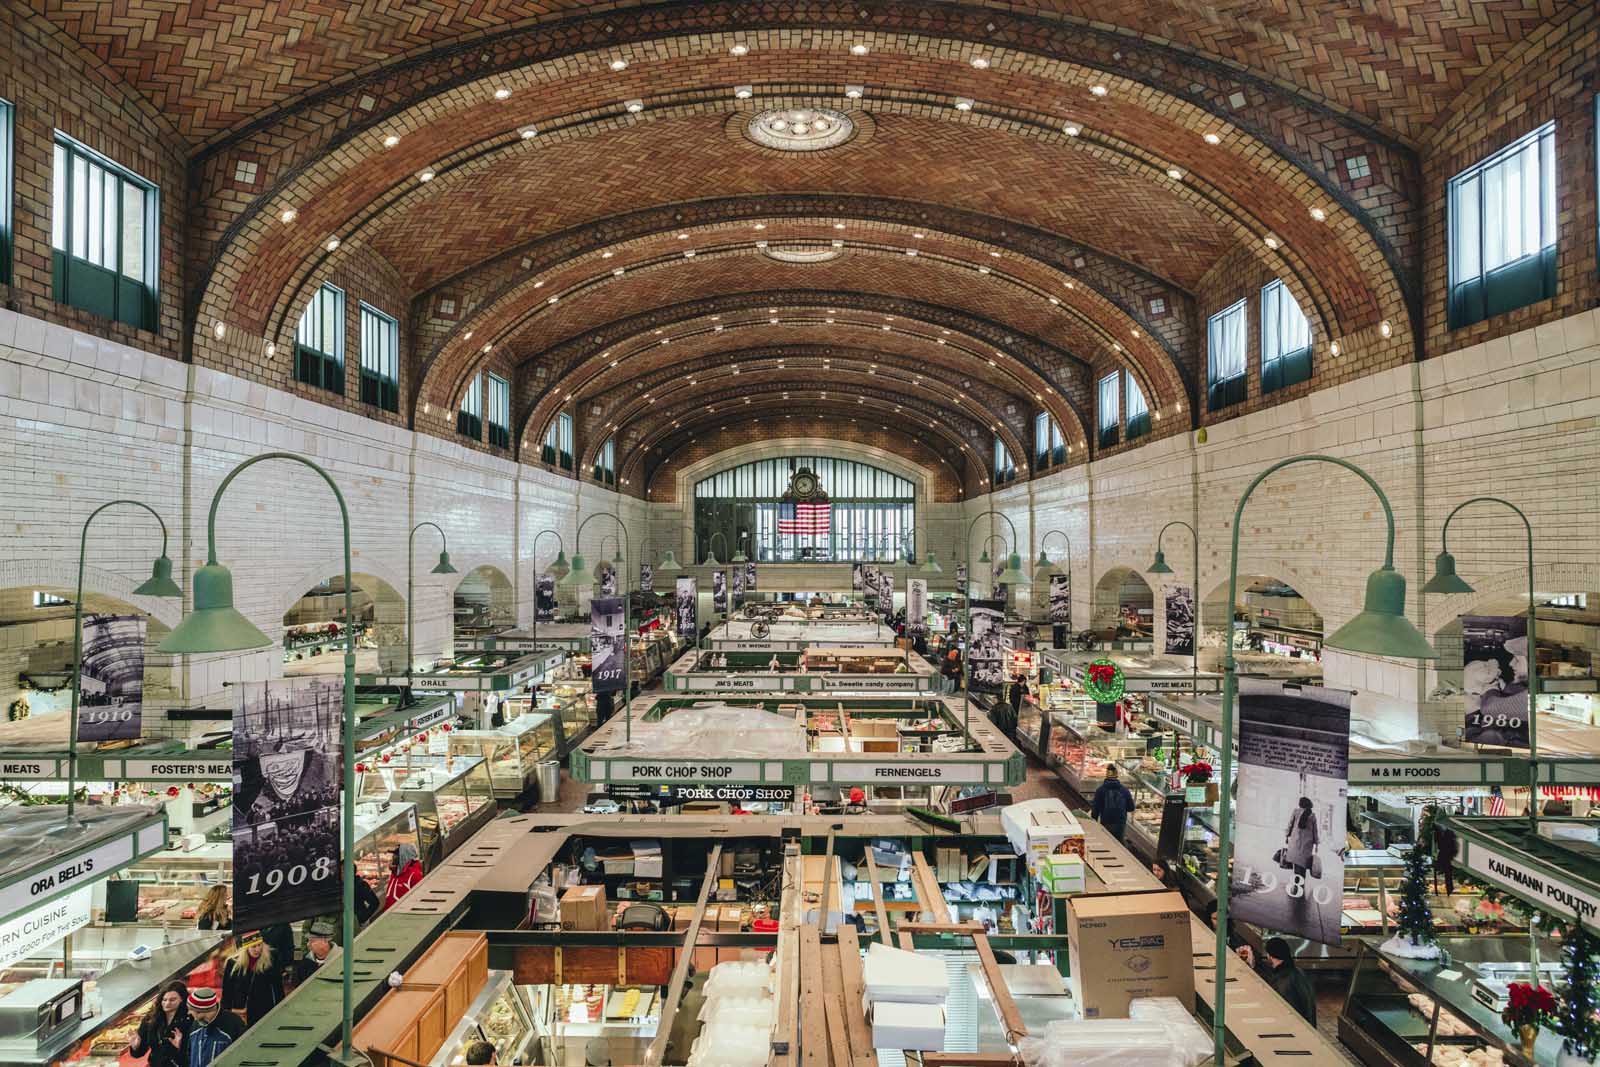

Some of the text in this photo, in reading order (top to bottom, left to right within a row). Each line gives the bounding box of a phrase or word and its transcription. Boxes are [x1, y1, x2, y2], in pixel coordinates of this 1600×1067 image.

[598, 669, 621, 680] 1917
[88, 711, 132, 724] 1910
[1472, 713, 1521, 728] 1980
[3, 764, 40, 774] MEATS
[151, 765, 232, 774] FOSTER'S MEA
[632, 766, 732, 777] PORK CHOP SHOP
[875, 767, 941, 777] FERNENGELS
[1371, 768, 1440, 776] M & M FOODS
[677, 788, 792, 799] PORK CHOP SHOP
[31, 859, 94, 895] ORA BELL'S
[245, 856, 330, 897] 1908
[1239, 866, 1332, 904] 1980
[1488, 858, 1598, 918] KAUFMANN POULTRY
[23, 906, 68, 935] CUISINE
